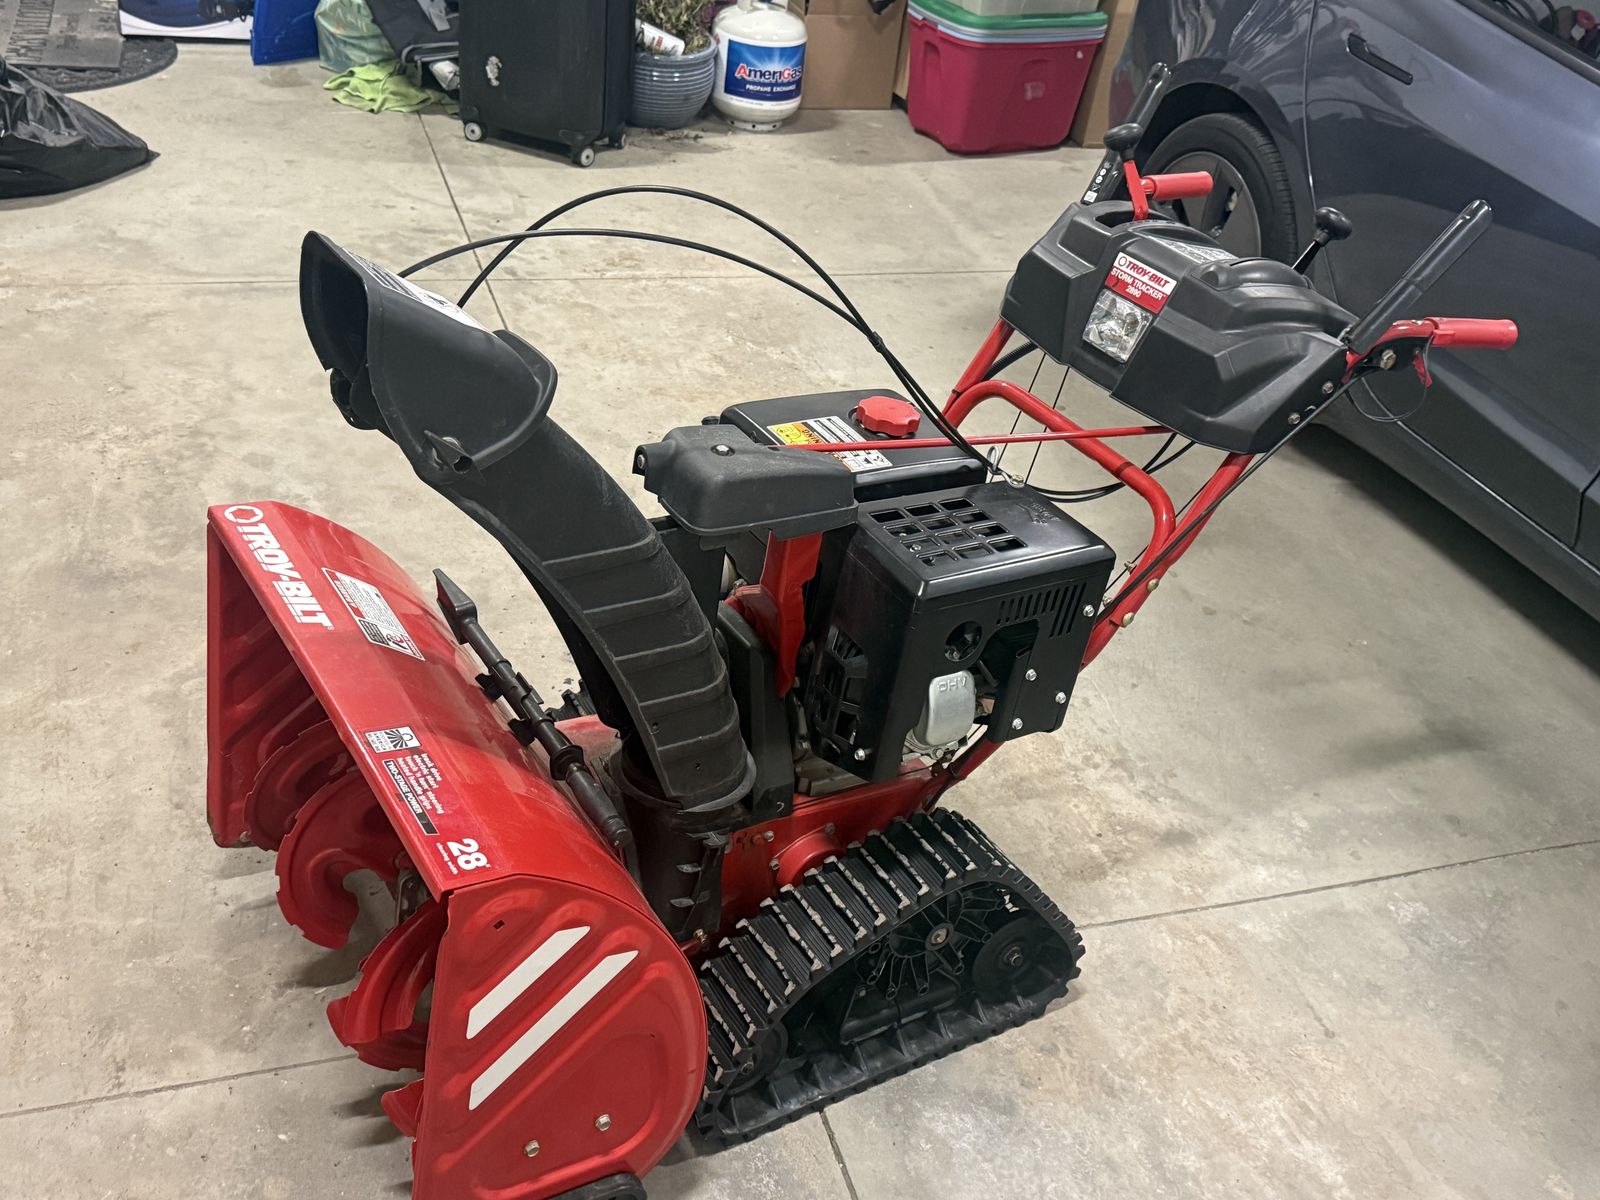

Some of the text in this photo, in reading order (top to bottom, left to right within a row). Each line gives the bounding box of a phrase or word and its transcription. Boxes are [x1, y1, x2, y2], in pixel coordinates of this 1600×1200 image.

[735, 64, 802, 82] AmeriGas
[746, 84, 796, 92] PROPANE EXCHANGE
[1111, 268, 1163, 300] STORM TRACKER
[1126, 261, 1169, 288] TROY-BILT
[1125, 285, 1142, 298] 2890
[802, 429, 822, 443] NING
[236, 522, 334, 630] TROY-BILT
[413, 754, 438, 788] electric start
[421, 753, 442, 781] track drive
[387, 760, 423, 814] TWO-STAGE POWER
[397, 757, 432, 809] heated handle grips
[405, 756, 418, 771] touch
[427, 791, 444, 814] steering
